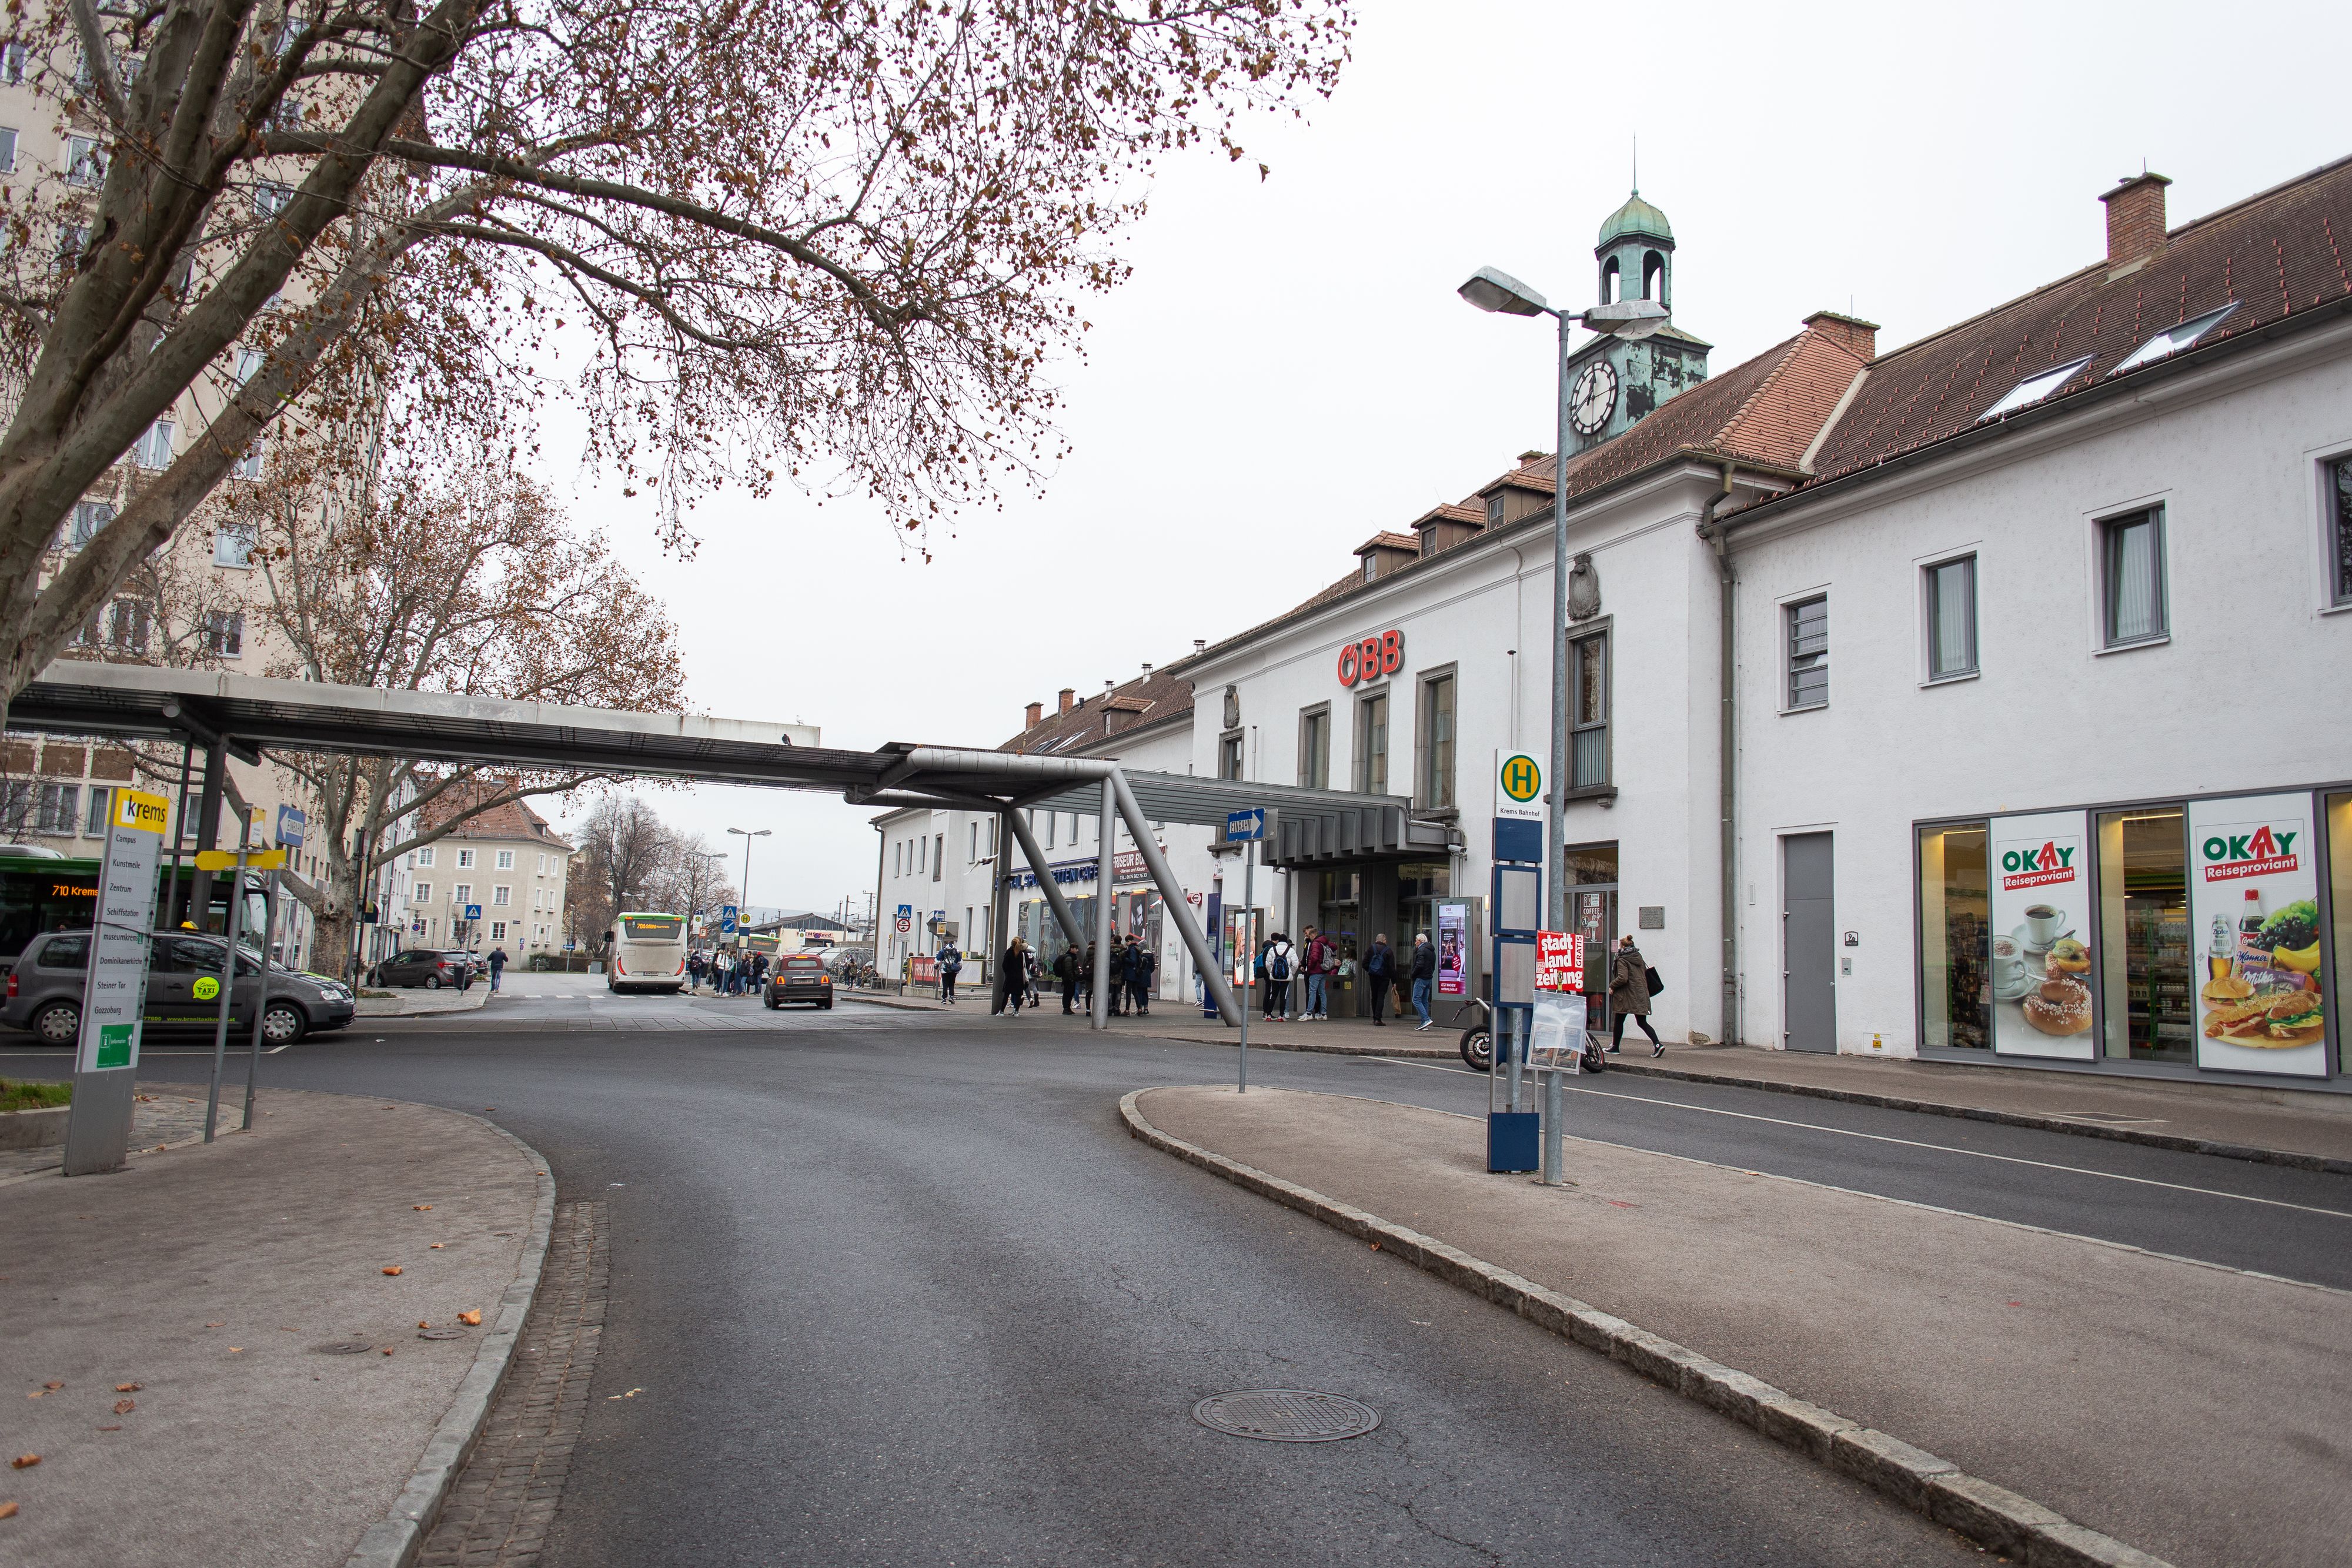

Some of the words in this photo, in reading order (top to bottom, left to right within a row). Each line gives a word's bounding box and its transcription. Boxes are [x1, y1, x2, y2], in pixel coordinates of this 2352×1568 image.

[1337, 630, 1405, 687] ÖBB
[128, 795, 166, 823] krems
[1231, 819, 1251, 833] EINBAHN
[116, 834, 136, 845] Campus
[2203, 825, 2297, 861] OKAY
[112, 858, 141, 869] Kunstmeile
[2002, 841, 2075, 872] OKAY
[2207, 857, 2296, 878] Reiseproviant
[2004, 869, 2073, 887] Reiseproviant
[52, 885, 69, 896] 710
[71, 887, 99, 896] Krems
[109, 882, 132, 893] Zentrum
[106, 907, 139, 917] Schiffstation
[1541, 932, 1573, 951] stadt
[100, 957, 142, 965] Dominikanerkirche
[1544, 949, 1572, 968] land
[2236, 950, 2268, 964] Manner
[97, 981, 116, 989] Steiner
[1536, 968, 1583, 989] zeitung
[2242, 971, 2276, 985] Milka
[95, 1006, 122, 1015] Gozzoburg
